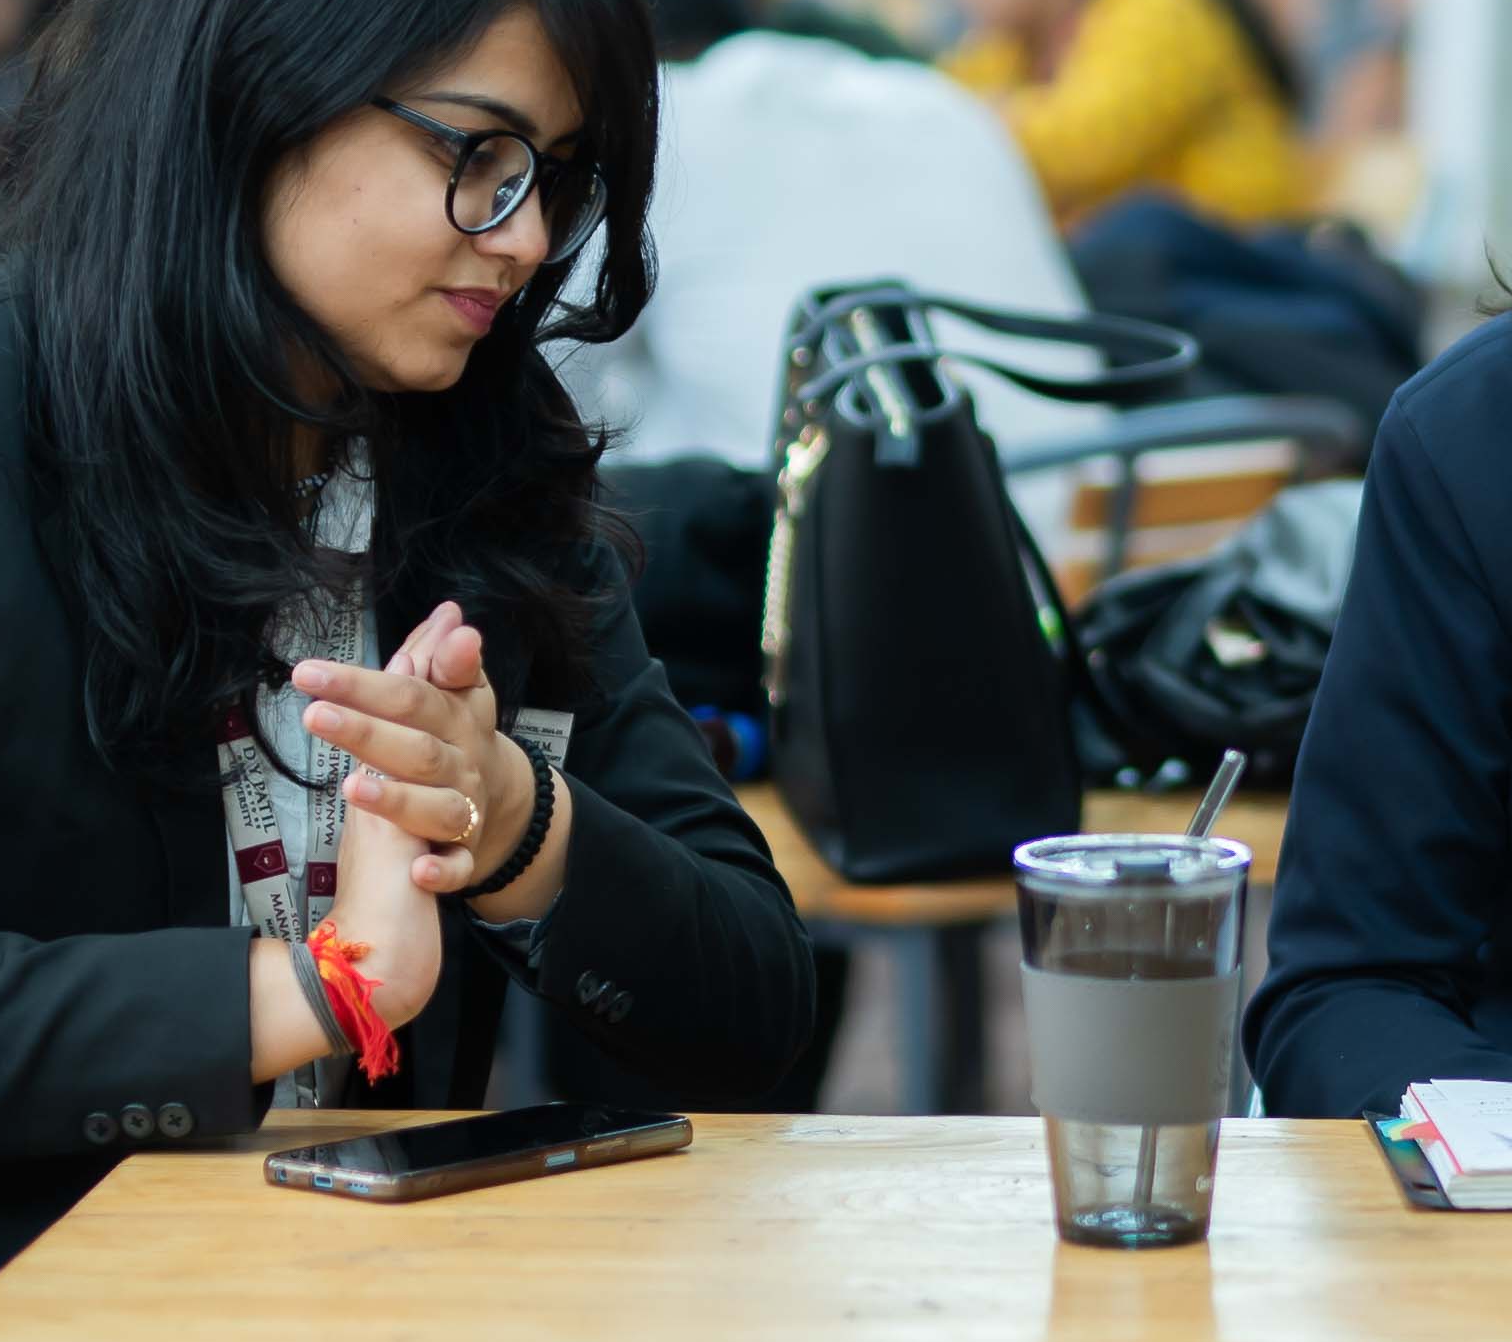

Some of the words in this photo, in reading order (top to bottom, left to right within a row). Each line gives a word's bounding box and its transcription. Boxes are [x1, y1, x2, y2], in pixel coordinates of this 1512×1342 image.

[243, 746, 256, 760] D
[249, 763, 262, 774] Y
[253, 780, 276, 834] PATIL
